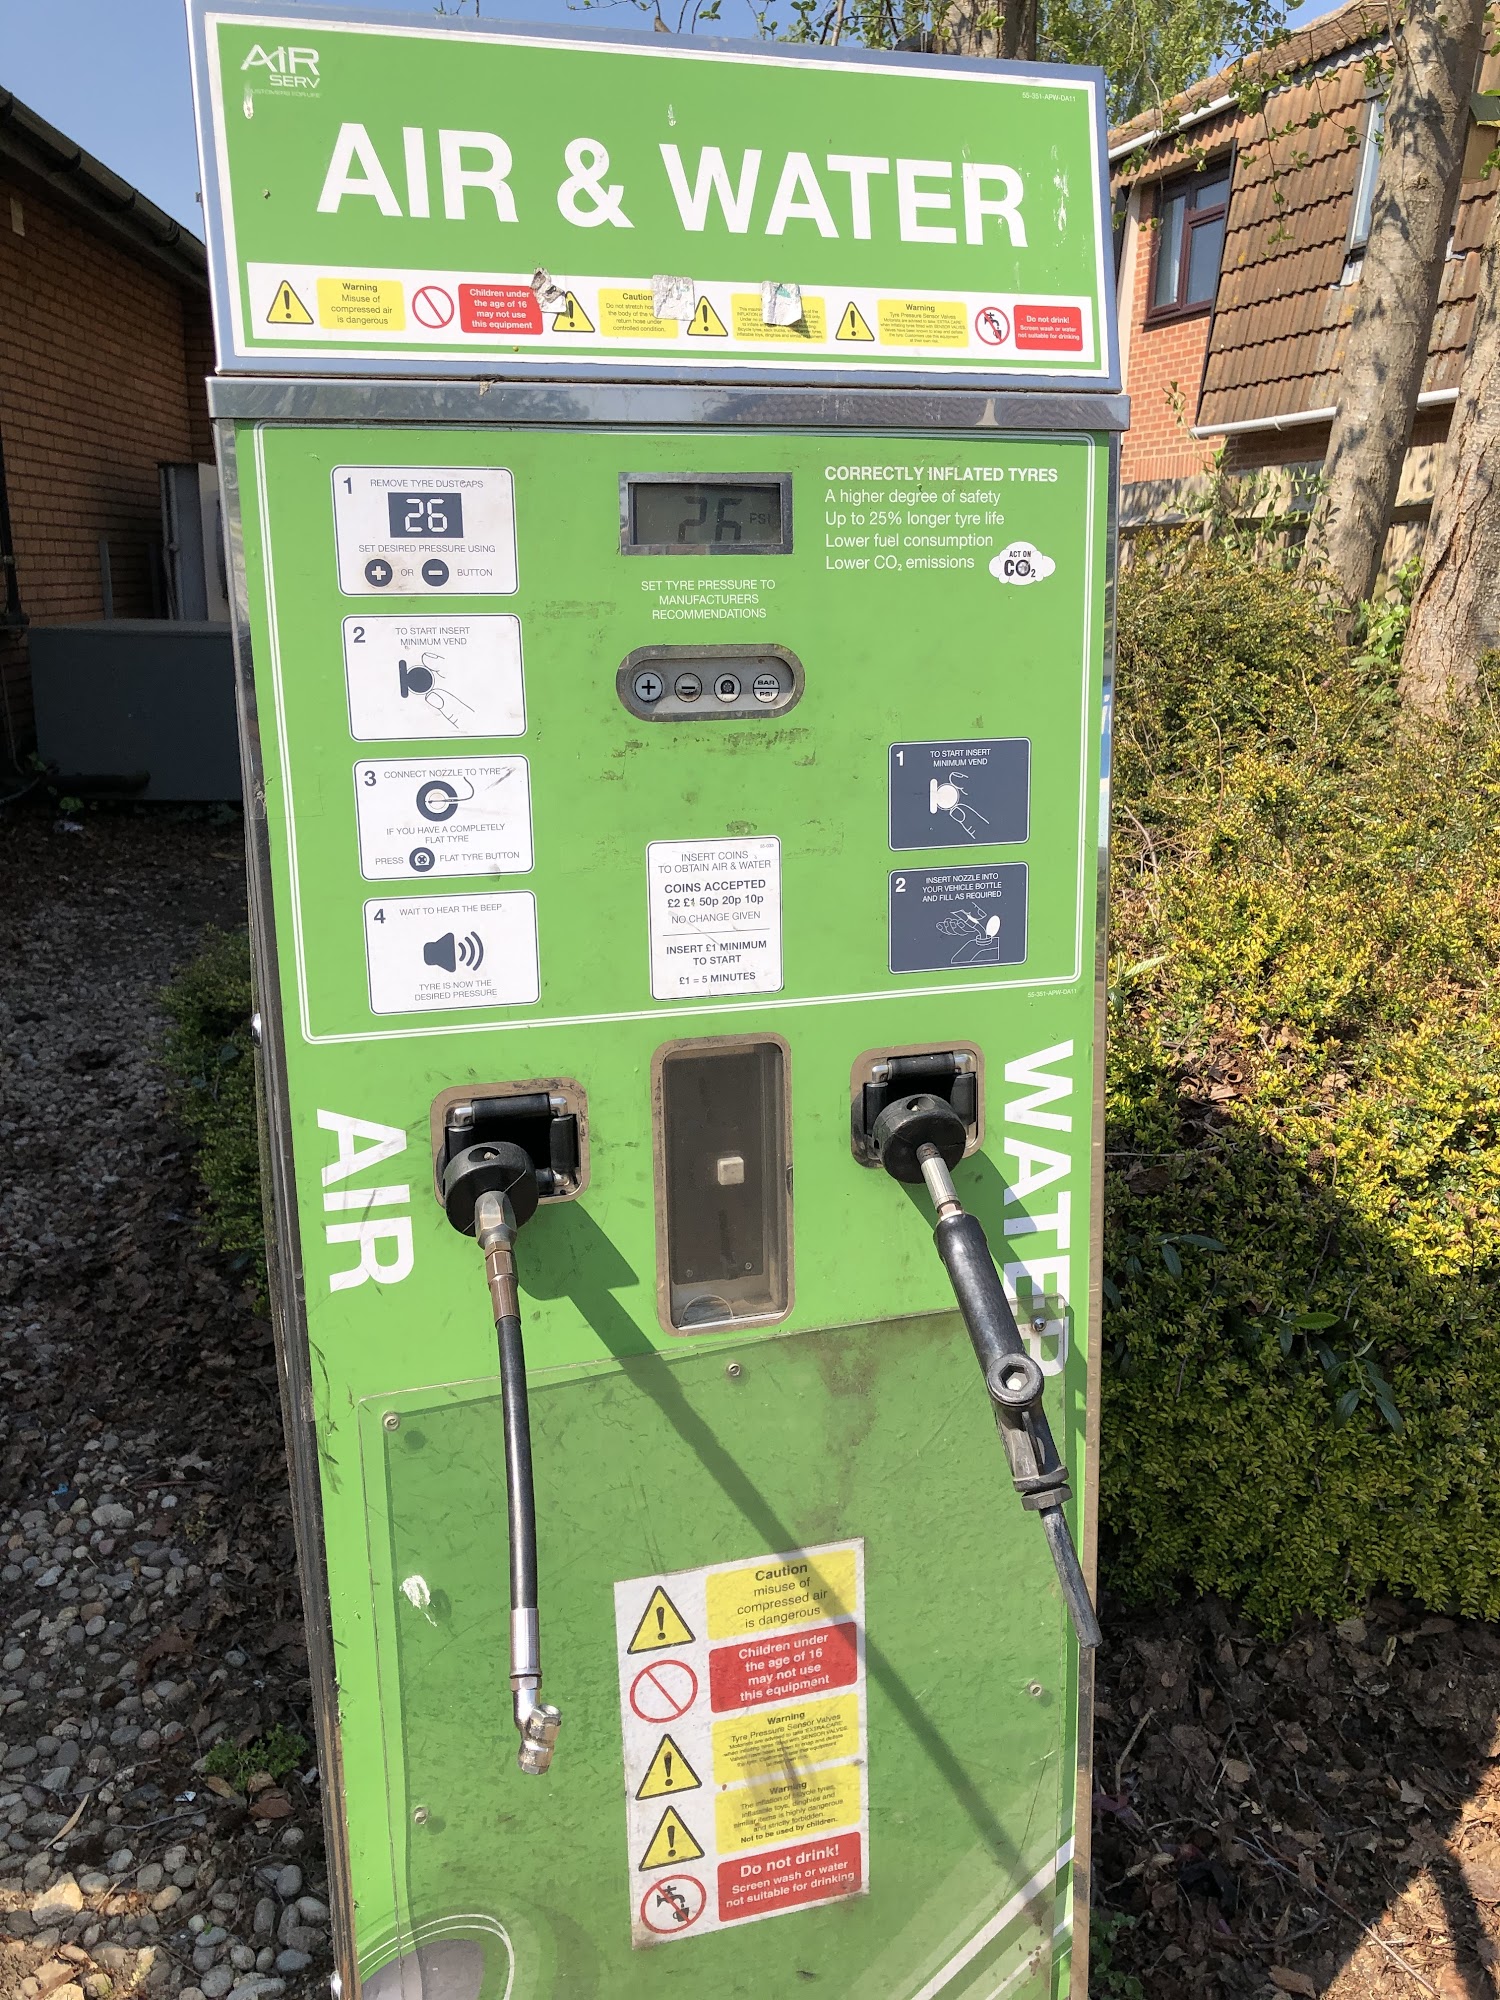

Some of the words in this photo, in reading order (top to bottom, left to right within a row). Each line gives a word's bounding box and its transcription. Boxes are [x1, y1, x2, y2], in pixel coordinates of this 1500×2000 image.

[240, 44, 320, 75] AIR
[270, 75, 320, 88] SERV
[317, 122, 519, 223] AIR
[557, 137, 635, 229] &
[659, 143, 1028, 248] WATER
[342, 283, 377, 292] Warning
[470, 289, 504, 297] Children
[342, 294, 370, 302] Misuse
[906, 304, 935, 312] Warning
[346, 316, 388, 325] dangerous
[825, 466, 923, 481] CORRECTLY
[928, 467, 1004, 481] INFLATED
[1008, 468, 1058, 482] TYRES
[343, 477, 352, 494] 1
[370, 479, 408, 487] REMOVE
[436, 480, 484, 488] DUSTCAPS
[825, 489, 836, 503] A
[840, 489, 883, 506] higher
[889, 489, 937, 506] degree
[942, 489, 956, 503] of
[960, 489, 1000, 506] safety
[404, 498, 448, 532] 26
[825, 511, 846, 528] Up
[851, 513, 865, 525] to
[869, 511, 902, 525] 25%
[907, 511, 951, 528] longer
[955, 513, 981, 528] tyre
[985, 511, 1004, 525] life
[825, 534, 869, 548] Lower
[874, 533, 899, 547] fuel
[903, 533, 993, 549] consumption
[468, 545, 496, 553] USING
[825, 556, 870, 570] Lower
[906, 555, 974, 569] emissions
[641, 581, 662, 591] SET
[665, 581, 694, 590] TYRE
[698, 580, 757, 590] PRESSURE
[760, 580, 775, 589] TO
[659, 594, 759, 605] MANUFACTURERS
[652, 608, 767, 619] RECOMMENDATIONS
[353, 626, 366, 643] 2
[439, 627, 470, 635] INSERT
[400, 638, 441, 646] MINIMUM
[896, 751, 904, 766] 1
[933, 759, 966, 767] MINIMUM
[968, 758, 988, 766] VEND
[364, 770, 377, 786] 3
[384, 770, 426, 779] CONNECT
[429, 769, 463, 777] NOZZLE
[375, 857, 404, 865] PRESS
[439, 854, 459, 862] FLAT
[461, 853, 483, 861] TYRE
[486, 852, 519, 860] BUTTON
[659, 865, 671, 874] TO
[675, 863, 709, 873] OBTAIN
[712, 862, 728, 871] AIR
[731, 862, 737, 870] &
[739, 860, 771, 869] WATER
[665, 883, 701, 893] COINS
[705, 879, 766, 891] ACCEPTED
[895, 877, 906, 893] 2
[668, 899, 680, 908] £2
[683, 897, 695, 907] £1
[699, 897, 719, 907] 50p
[722, 895, 742, 906] 20p
[745, 894, 764, 904] 10p
[373, 908, 386, 923] 4
[400, 908, 420, 916] WAIT
[423, 907, 434, 915] TO
[436, 906, 459, 914] HEAR
[666, 945, 703, 954] INSERT
[706, 944, 716, 952] £1
[720, 940, 766, 951] MINIMUM
[693, 957, 707, 965] TO
[710, 955, 741, 964] START
[679, 976, 689, 984] £1
[702, 975, 708, 983] 5
[710, 972, 756, 983] MINUTES
[317, 1108, 415, 1293] AIR
[755, 1564, 808, 1581] Caution
[754, 1582, 795, 1596] misuse
[799, 1577, 811, 1588] of
[737, 1593, 809, 1615] compressed
[813, 1590, 828, 1600] air
[745, 1619, 755, 1628] is
[759, 1606, 820, 1626] dangerous
[738, 1641, 790, 1660] Children
[794, 1634, 829, 1649] under
[745, 1661, 765, 1673] the
[768, 1657, 790, 1669] age
[794, 1651, 806, 1662] of
[808, 1648, 823, 1658] 16
[748, 1673, 773, 1686] may
[776, 1668, 797, 1680] not
[800, 1663, 821, 1675] use
[740, 1691, 763, 1702] this
[766, 1675, 829, 1697] equipment
[767, 1712, 805, 1725] Warning
[731, 1735, 747, 1743] Tyre
[750, 1726, 785, 1739] Pressure
[787, 1720, 814, 1731] Sensor
[816, 1714, 841, 1724] Valves
[740, 1864, 762, 1878] Do
[767, 1855, 791, 1871] not
[795, 1843, 839, 1865] drink!
[732, 1879, 770, 1894] Screen
[773, 1870, 802, 1885] wash
[805, 1868, 817, 1877] or
[819, 1861, 848, 1874] water
[726, 1898, 745, 1908] not
[747, 1887, 790, 1903] suitable
[793, 1882, 808, 1892] for
[811, 1871, 855, 1888] drinking
